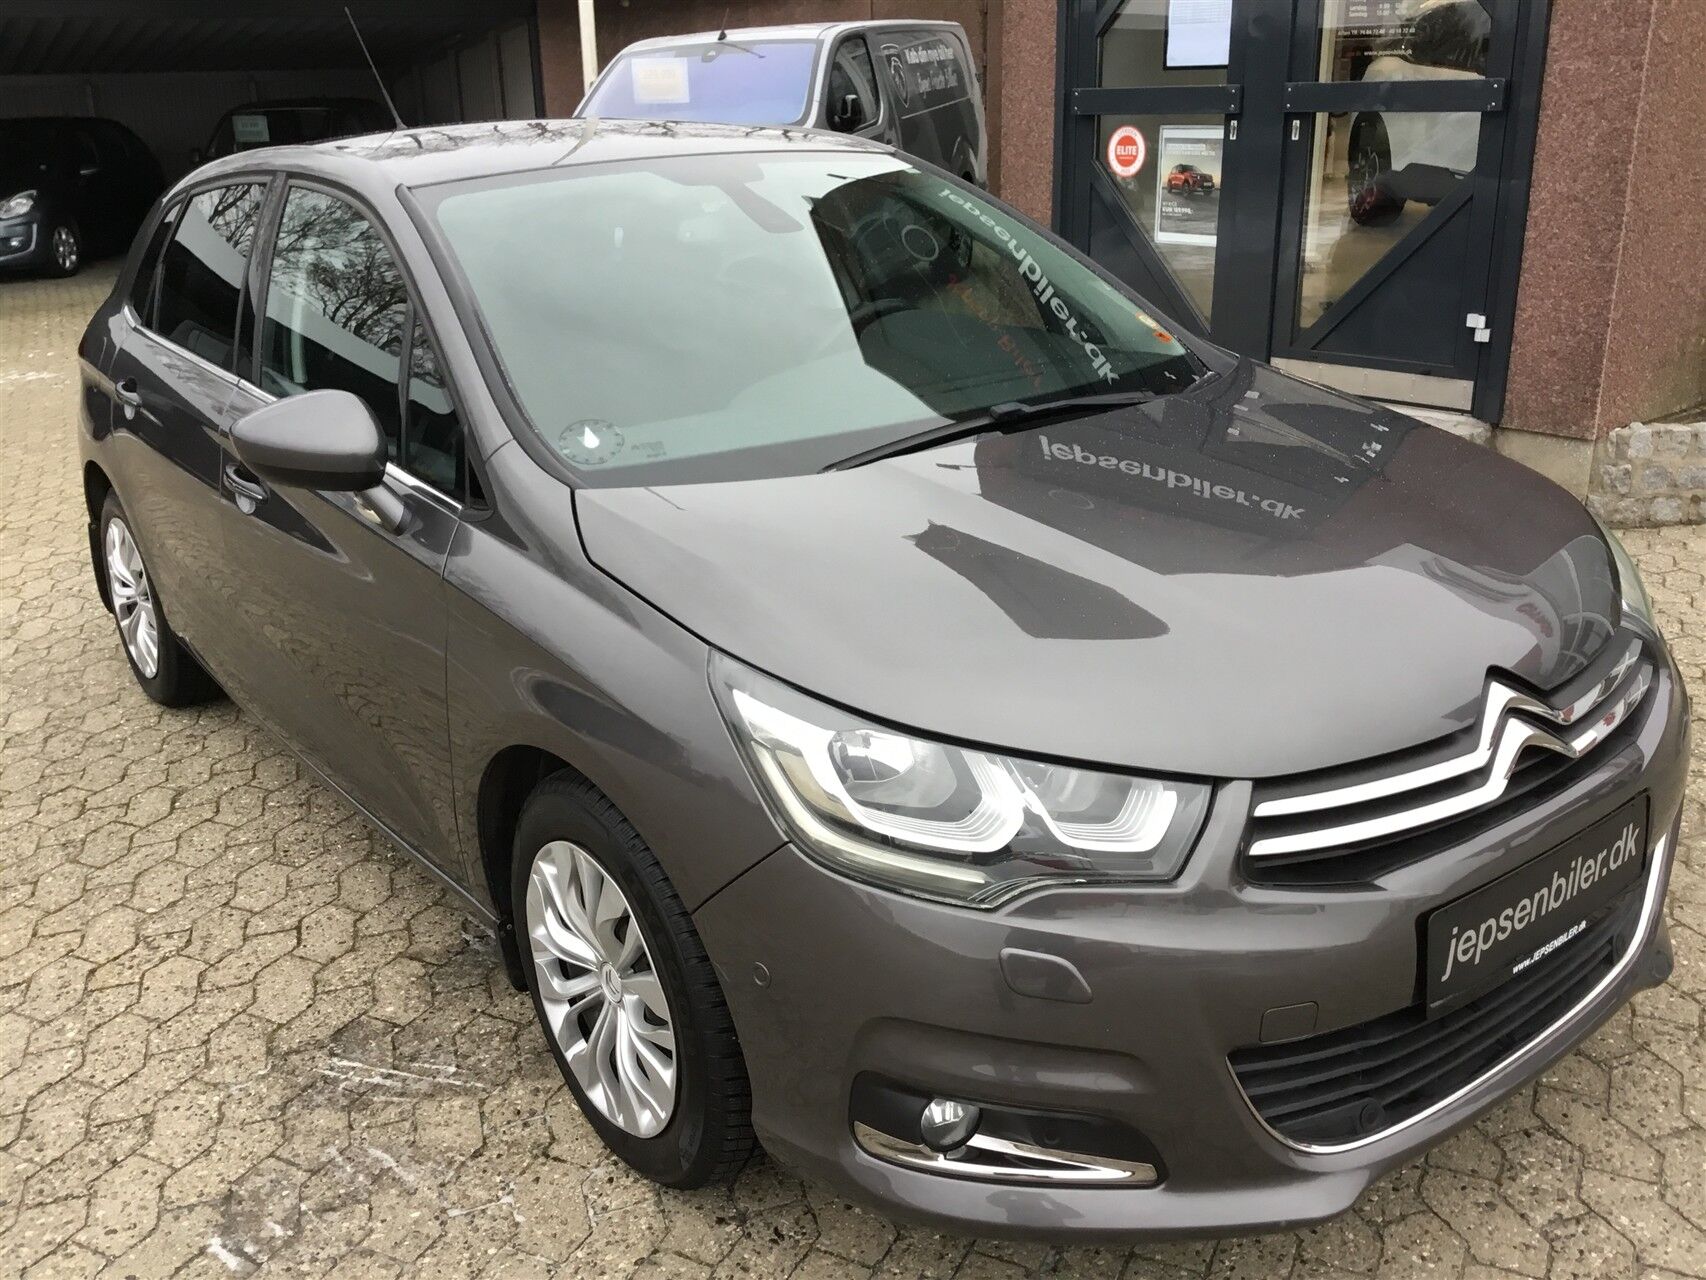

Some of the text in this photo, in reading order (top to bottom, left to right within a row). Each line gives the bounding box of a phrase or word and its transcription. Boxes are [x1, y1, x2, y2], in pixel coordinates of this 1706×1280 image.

[1116, 145, 1137, 155] ELITE
[1441, 822, 1640, 982] jepsenbiler.dk
[1512, 920, 1587, 974] www.JEPSENBILER.dk
